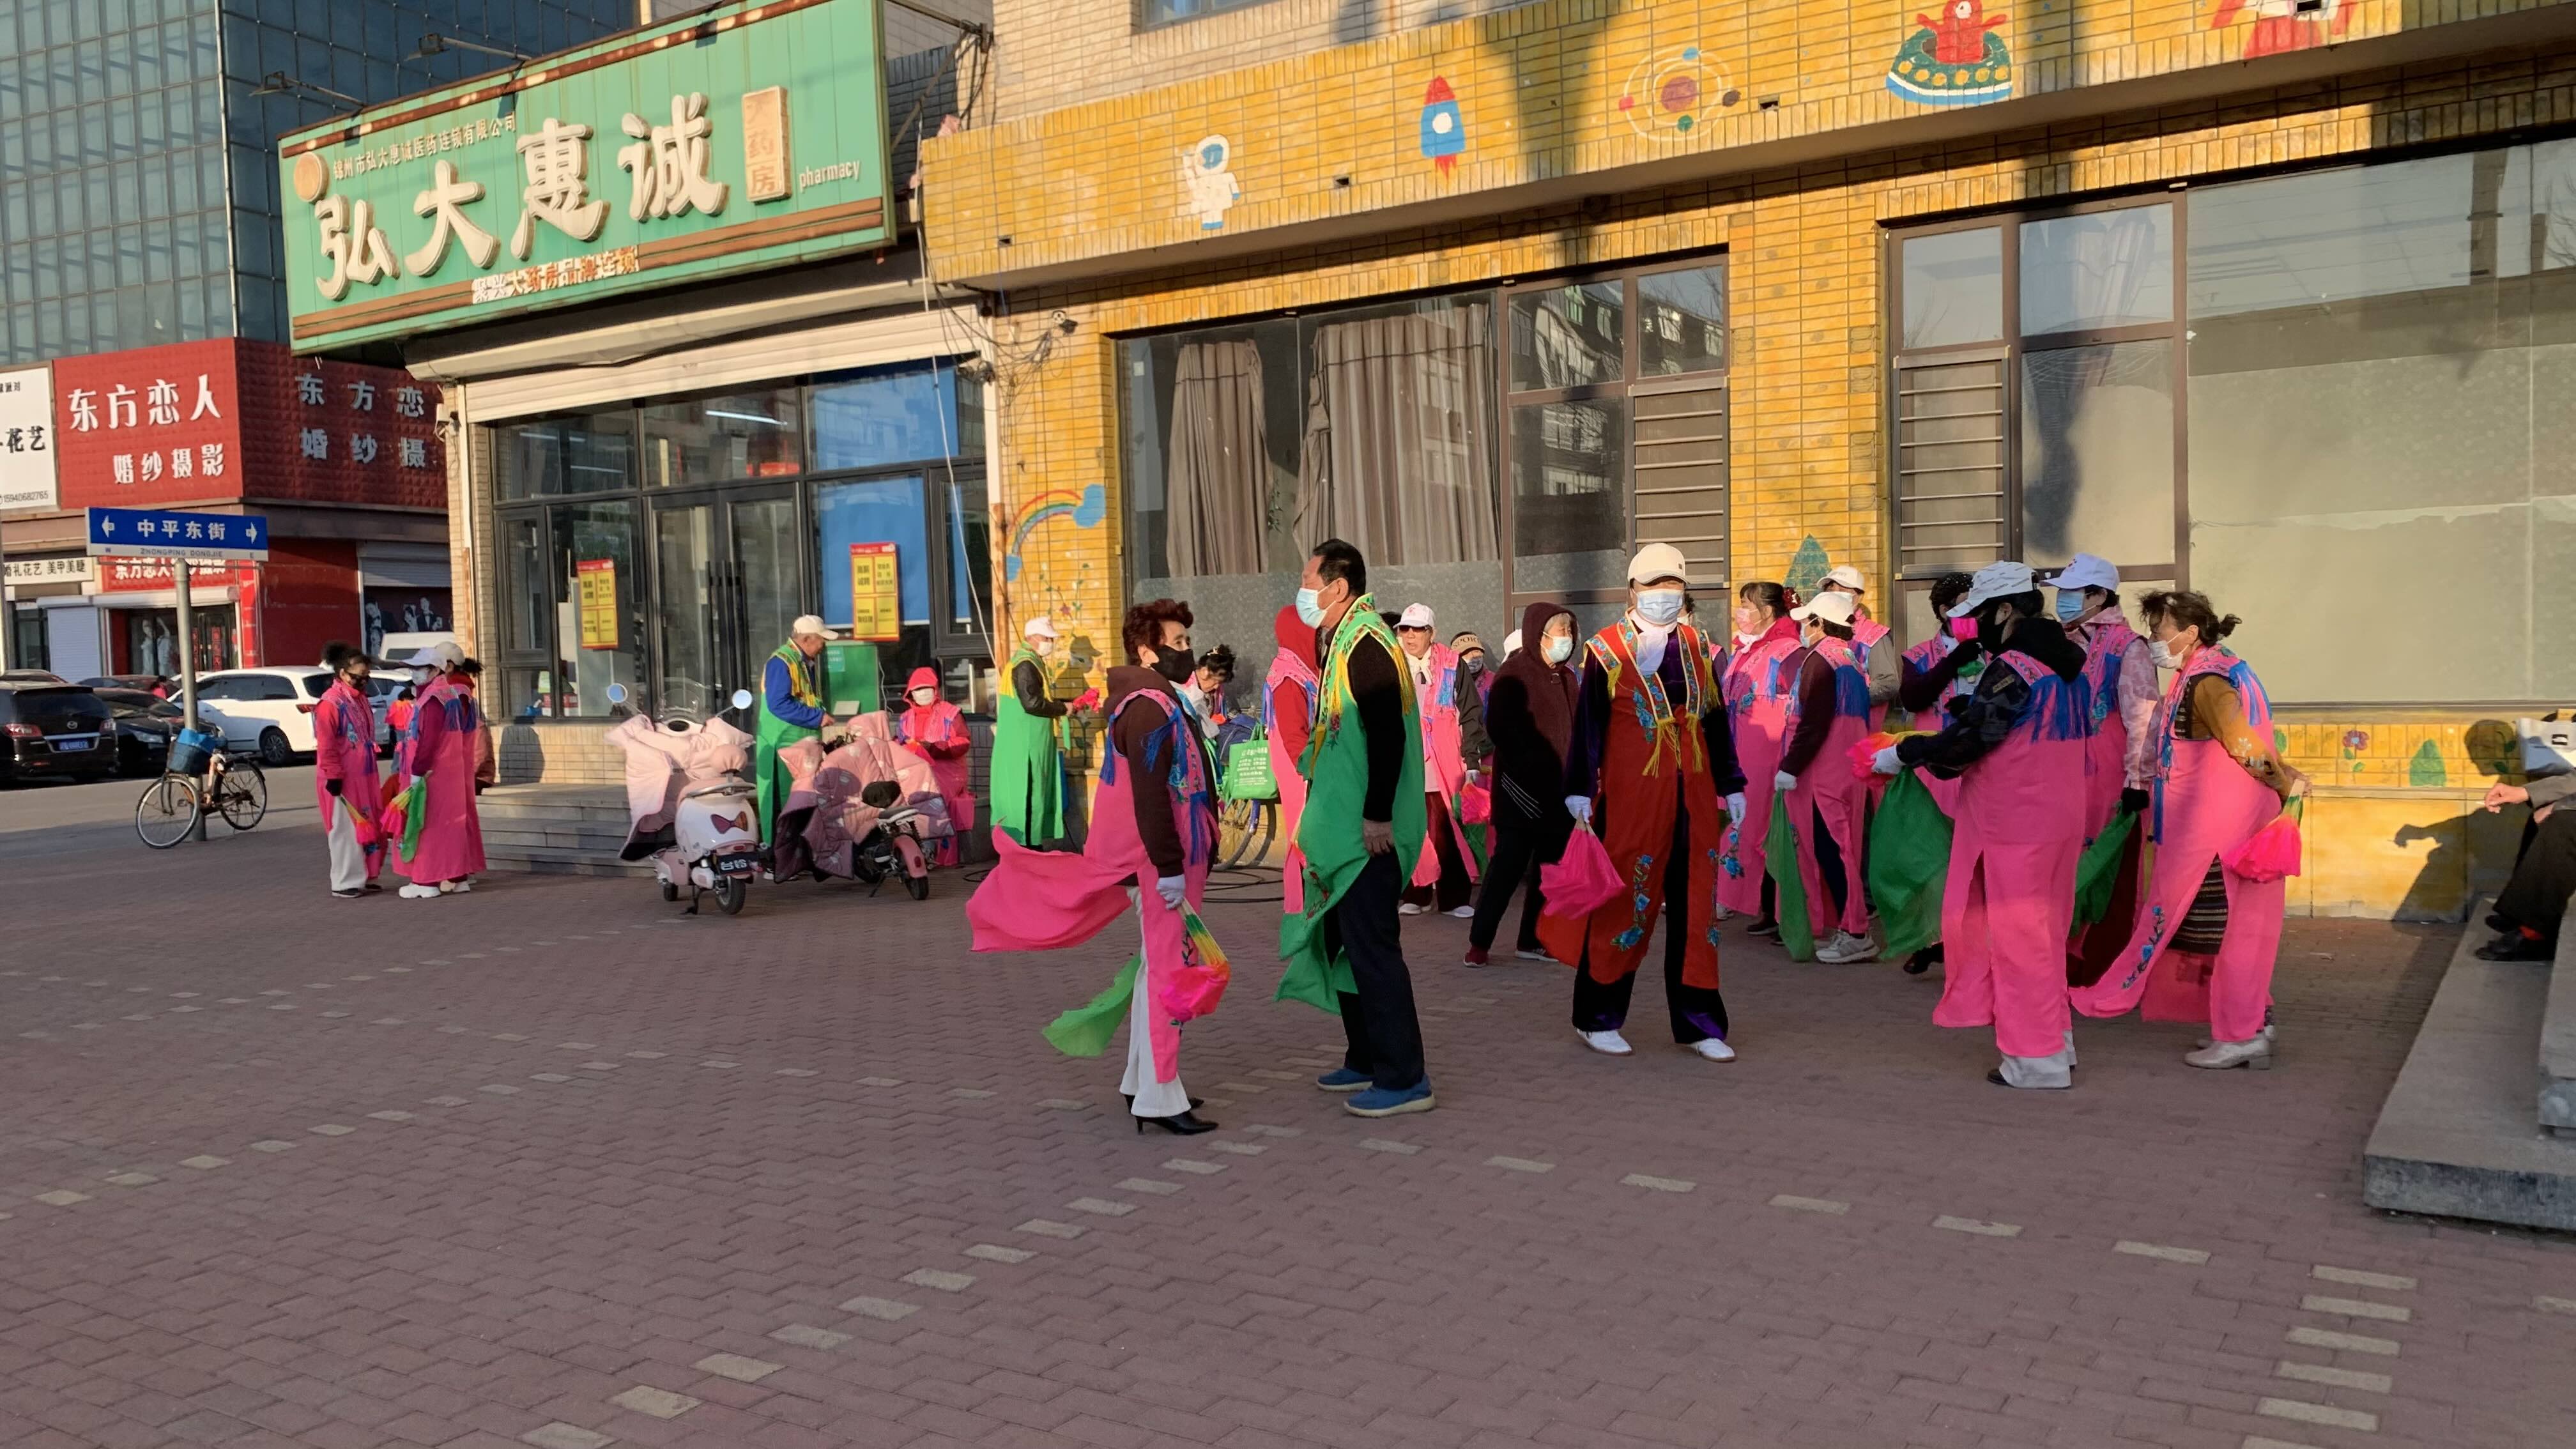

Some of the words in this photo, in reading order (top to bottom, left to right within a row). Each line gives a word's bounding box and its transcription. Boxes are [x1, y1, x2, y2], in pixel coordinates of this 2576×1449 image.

[746, 93, 776, 195] 大药房
[314, 91, 728, 302] 弘大惠诚
[799, 160, 861, 194] pharmacy
[67, 373, 222, 433] 东方恋人
[295, 372, 425, 418] 东方恋
[112, 443, 224, 484] 婚纱摄影
[300, 427, 426, 468] 婚纱摄
[137, 518, 226, 540] 中平东街
[140, 548, 186, 556] ZHONGPING
[190, 549, 224, 558] DONGJIE
